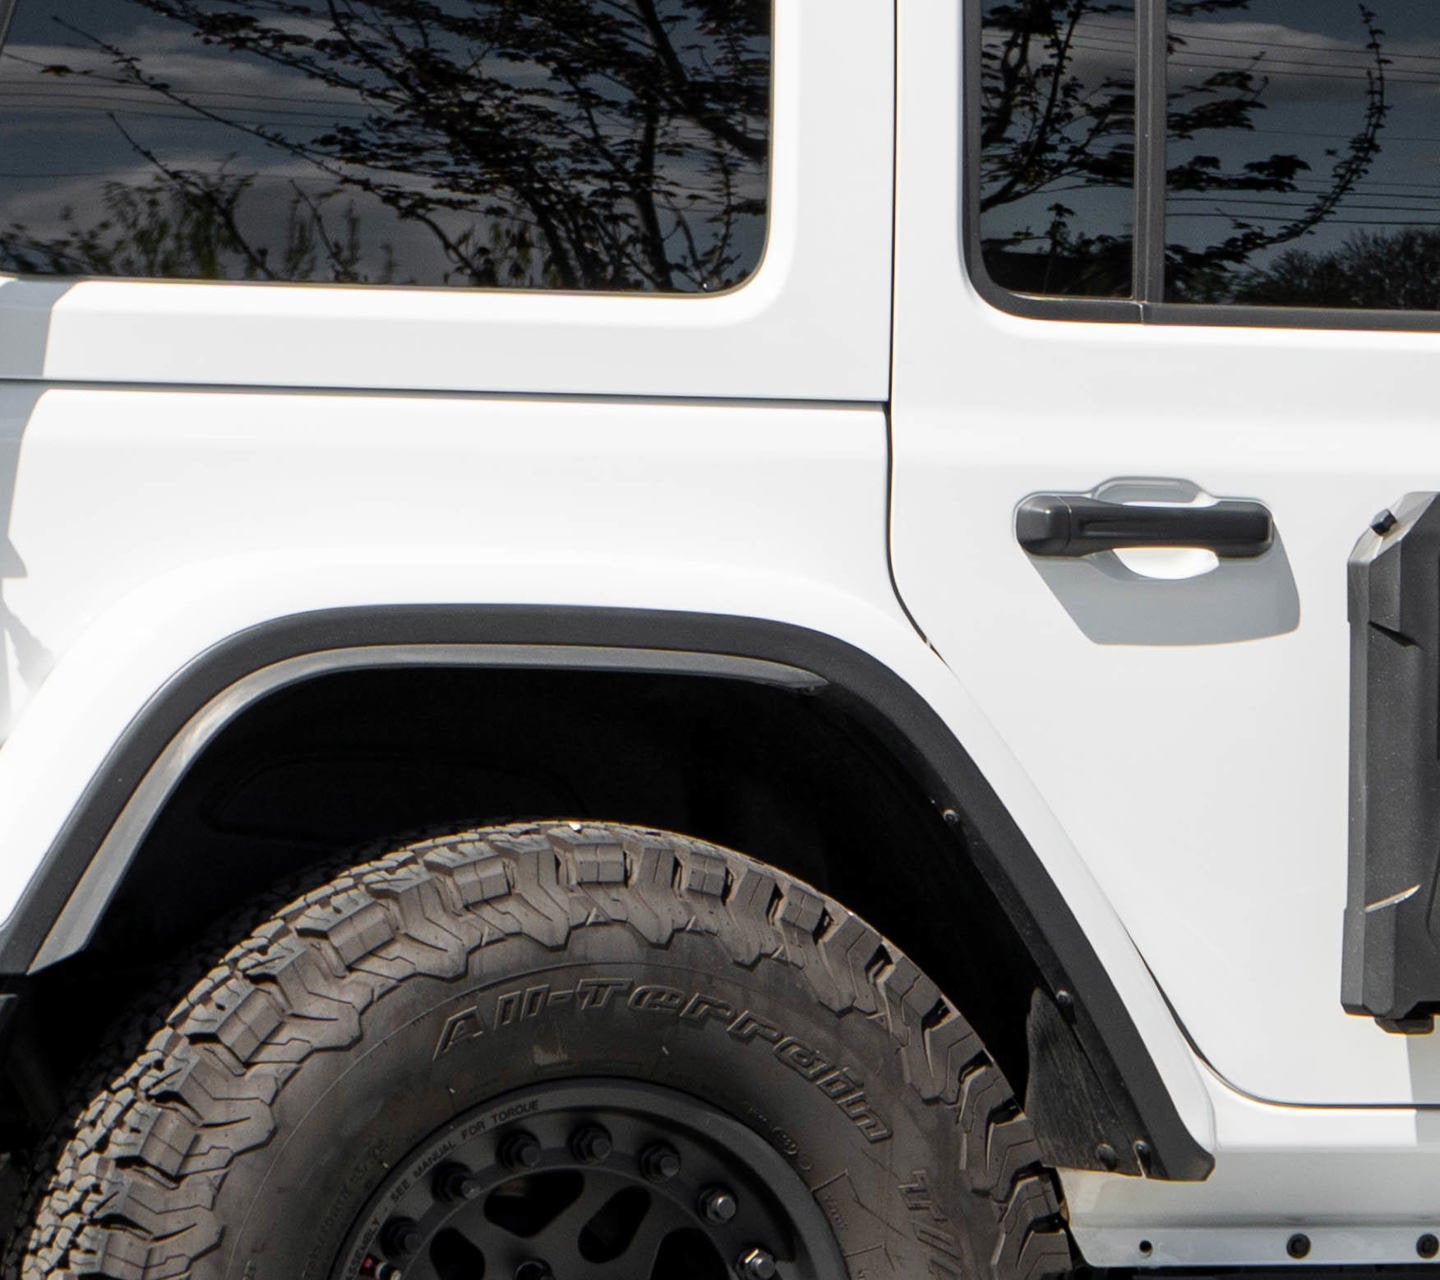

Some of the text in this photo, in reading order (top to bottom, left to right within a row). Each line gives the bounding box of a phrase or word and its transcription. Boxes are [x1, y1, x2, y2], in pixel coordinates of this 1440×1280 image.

[433, 976, 893, 1144] All-Terrain
[389, 1179, 412, 1205] SEE
[413, 1140, 457, 1179] MANUAL
[461, 1120, 487, 1141] FOR
[491, 1098, 540, 1124] TORQUE
